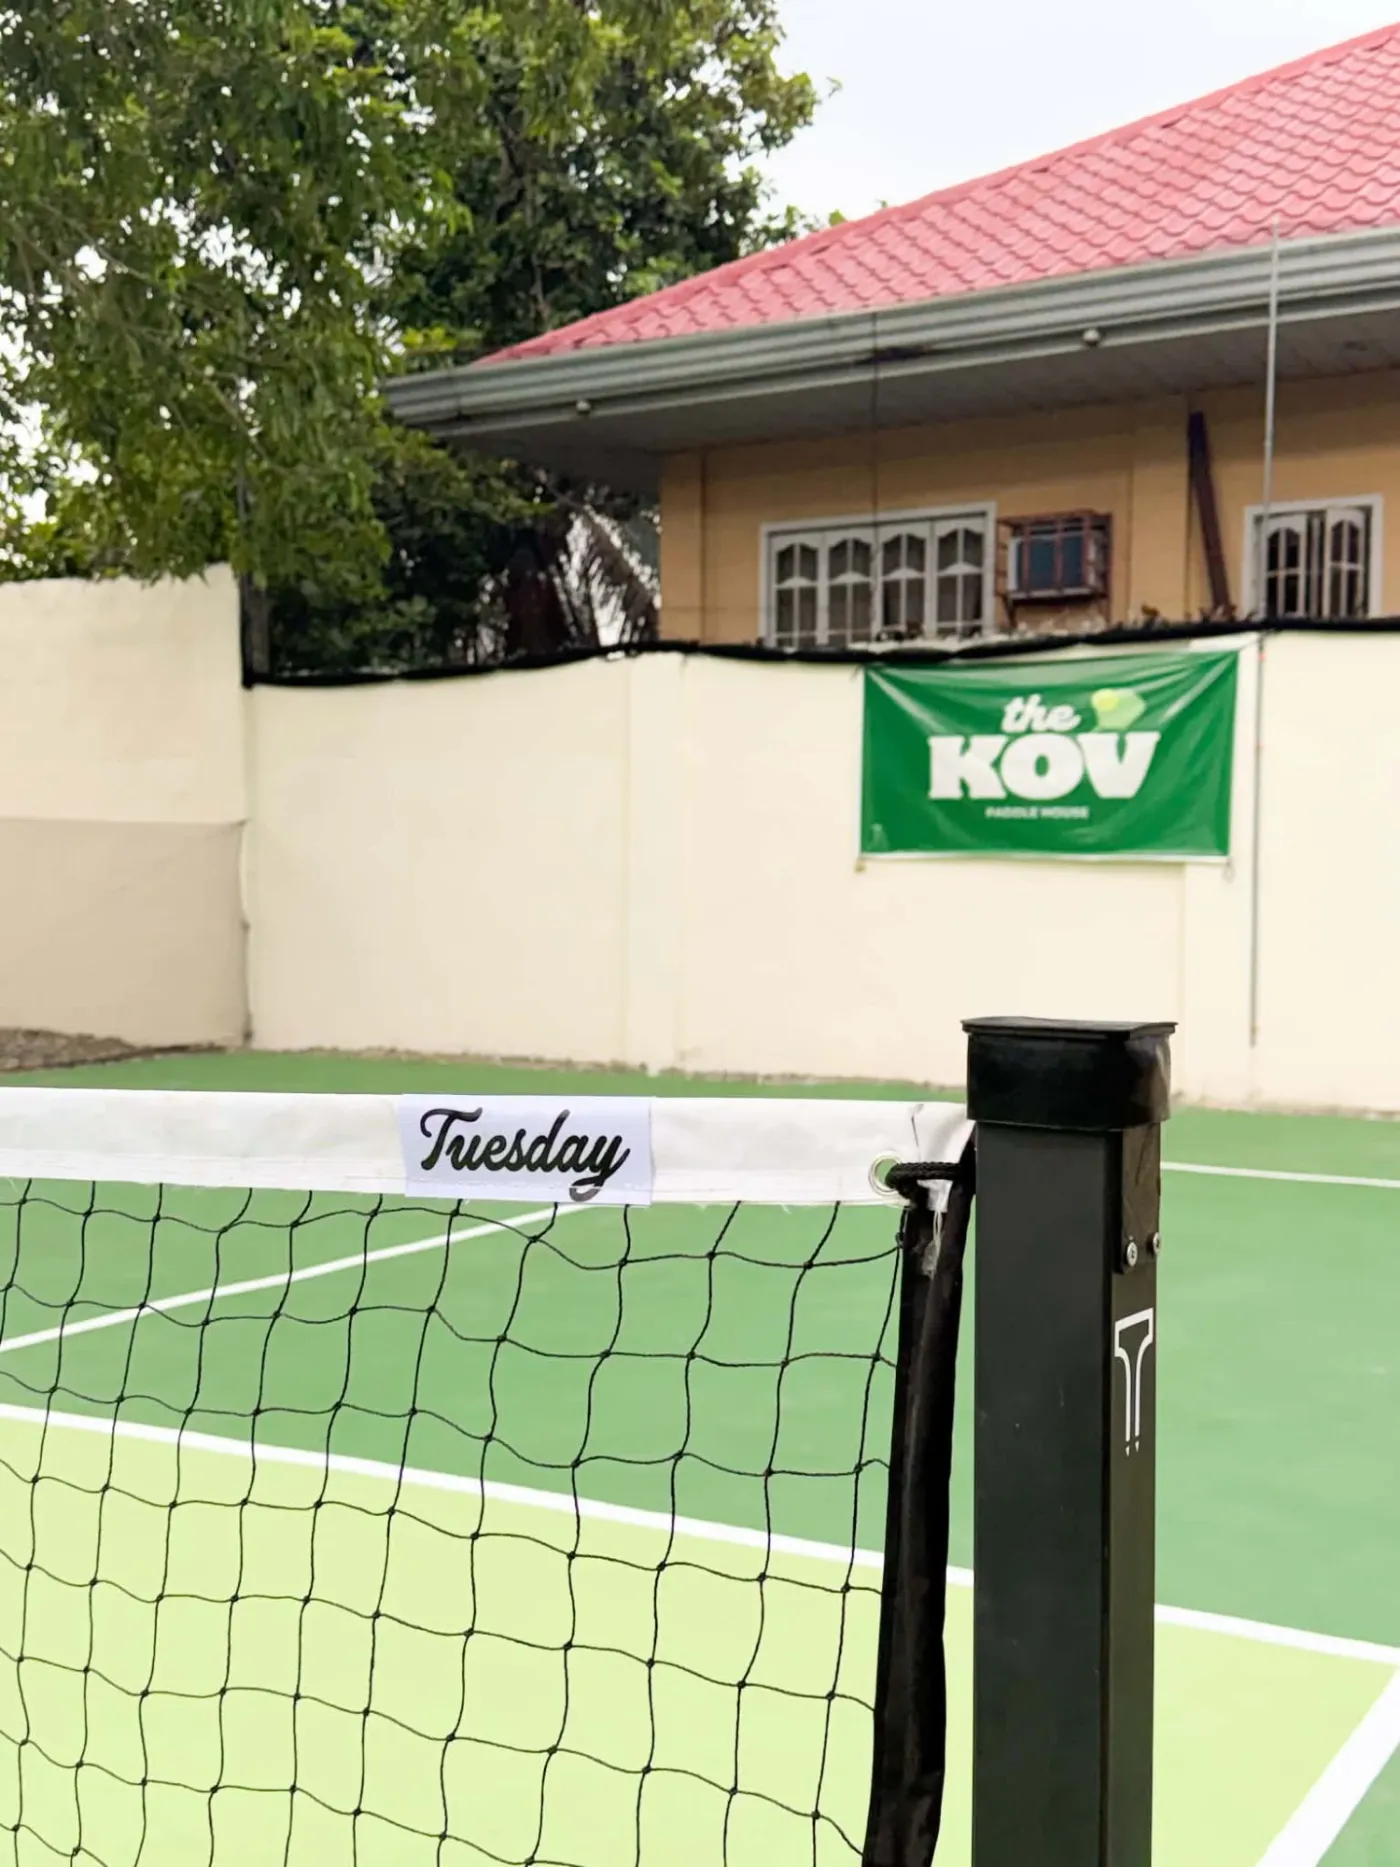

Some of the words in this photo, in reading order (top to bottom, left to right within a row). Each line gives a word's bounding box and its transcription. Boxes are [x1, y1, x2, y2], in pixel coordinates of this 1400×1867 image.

[1001, 694, 1082, 732] the
[927, 732, 1161, 800] KOV
[1041, 806, 1089, 819] HOUSE
